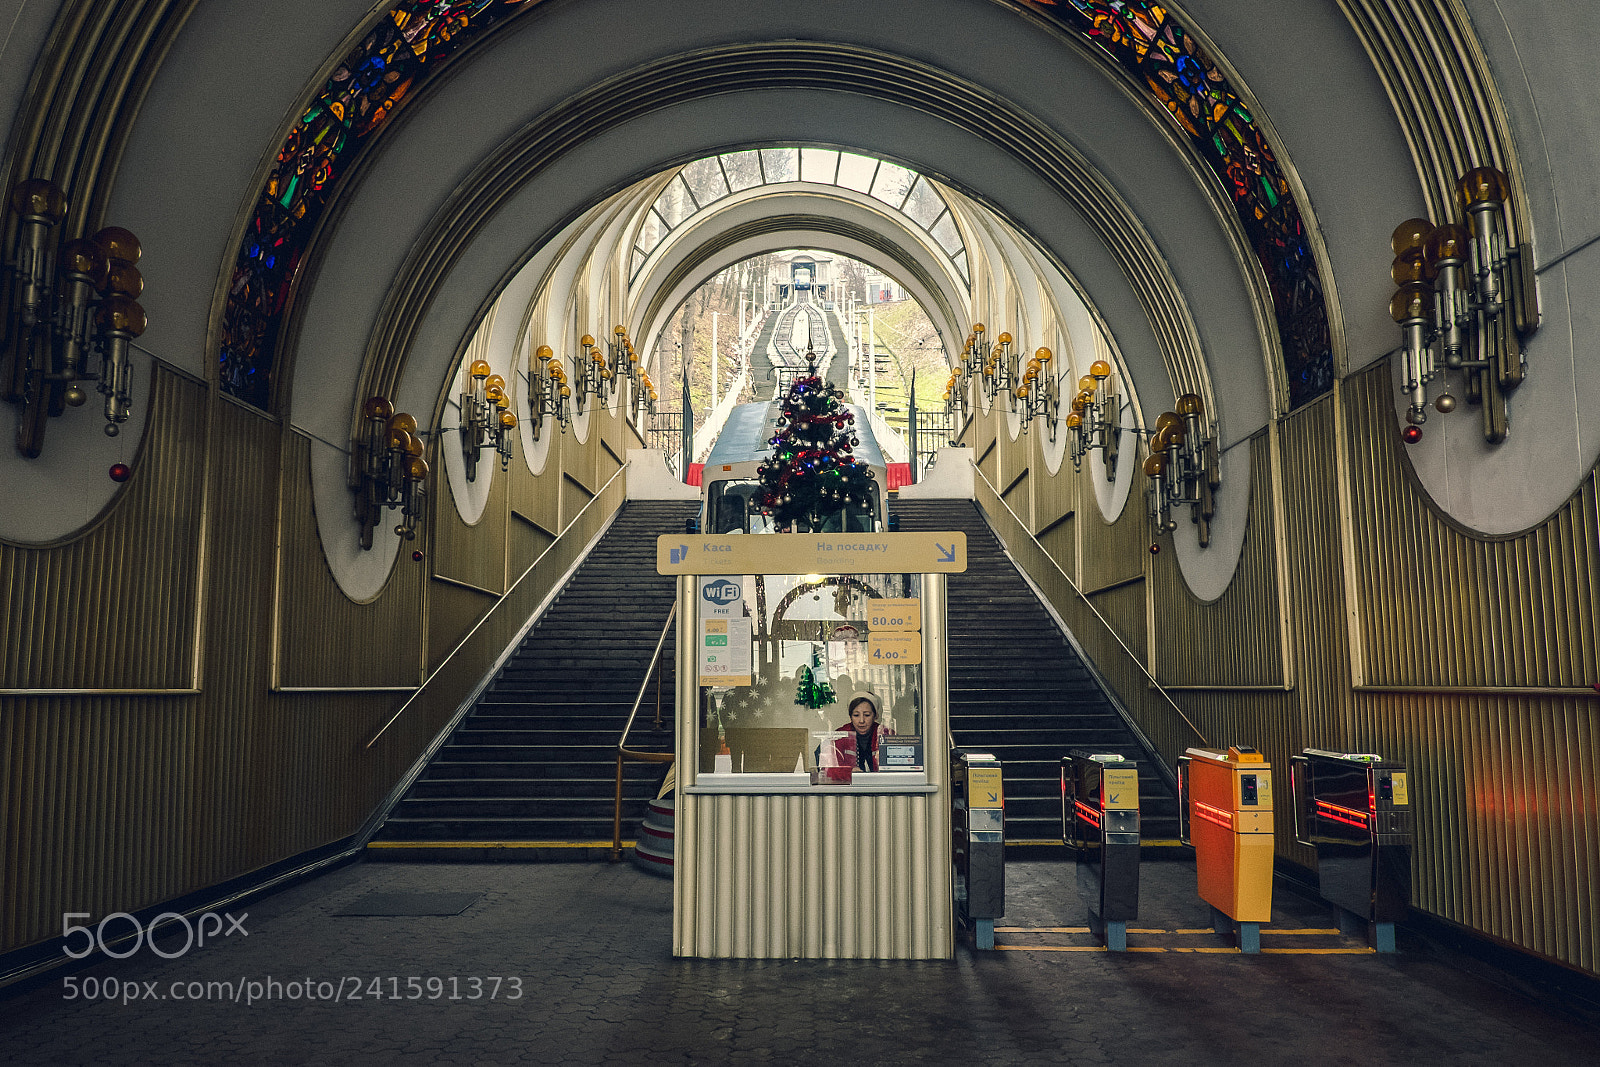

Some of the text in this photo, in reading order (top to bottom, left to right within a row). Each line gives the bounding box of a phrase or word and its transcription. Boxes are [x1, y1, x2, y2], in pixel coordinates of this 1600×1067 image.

[703, 543, 732, 552] Каса
[817, 542, 889, 552] На посадку
[816, 557, 855, 565] Boarding
[872, 616, 904, 626] 80.00
[873, 648, 900, 660] 4.00
